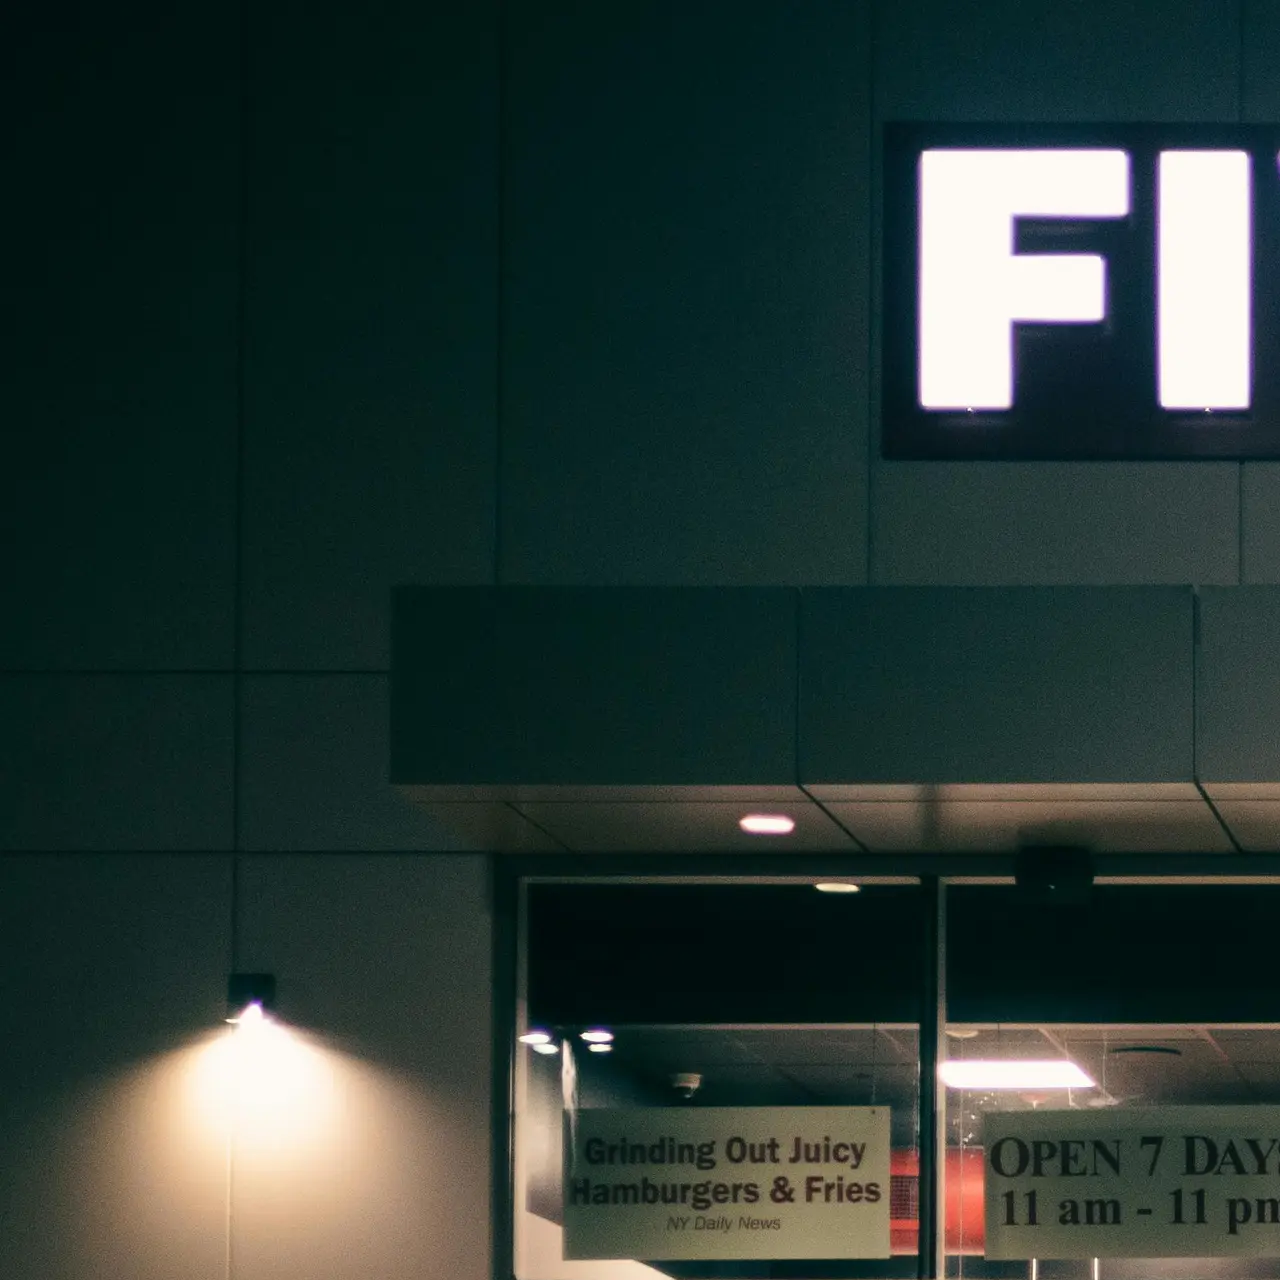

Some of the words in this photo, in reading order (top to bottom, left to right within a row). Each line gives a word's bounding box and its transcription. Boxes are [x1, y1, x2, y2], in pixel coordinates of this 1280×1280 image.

[584, 1137, 716, 1170] Grinding
[725, 1137, 782, 1164] Out
[789, 1137, 867, 1172] Juicy
[990, 1136, 1123, 1178] OPEN
[1139, 1135, 1164, 1177] 7
[570, 1177, 765, 1212] Hamburgers
[770, 1176, 796, 1204] &
[805, 1175, 882, 1204] Fries
[1001, 1189, 1040, 1227] 11
[1058, 1198, 1121, 1227] am
[1169, 1187, 1209, 1226] 11
[666, 1214, 691, 1231] NY
[694, 1214, 734, 1235] Daily
[736, 1214, 782, 1232] News
